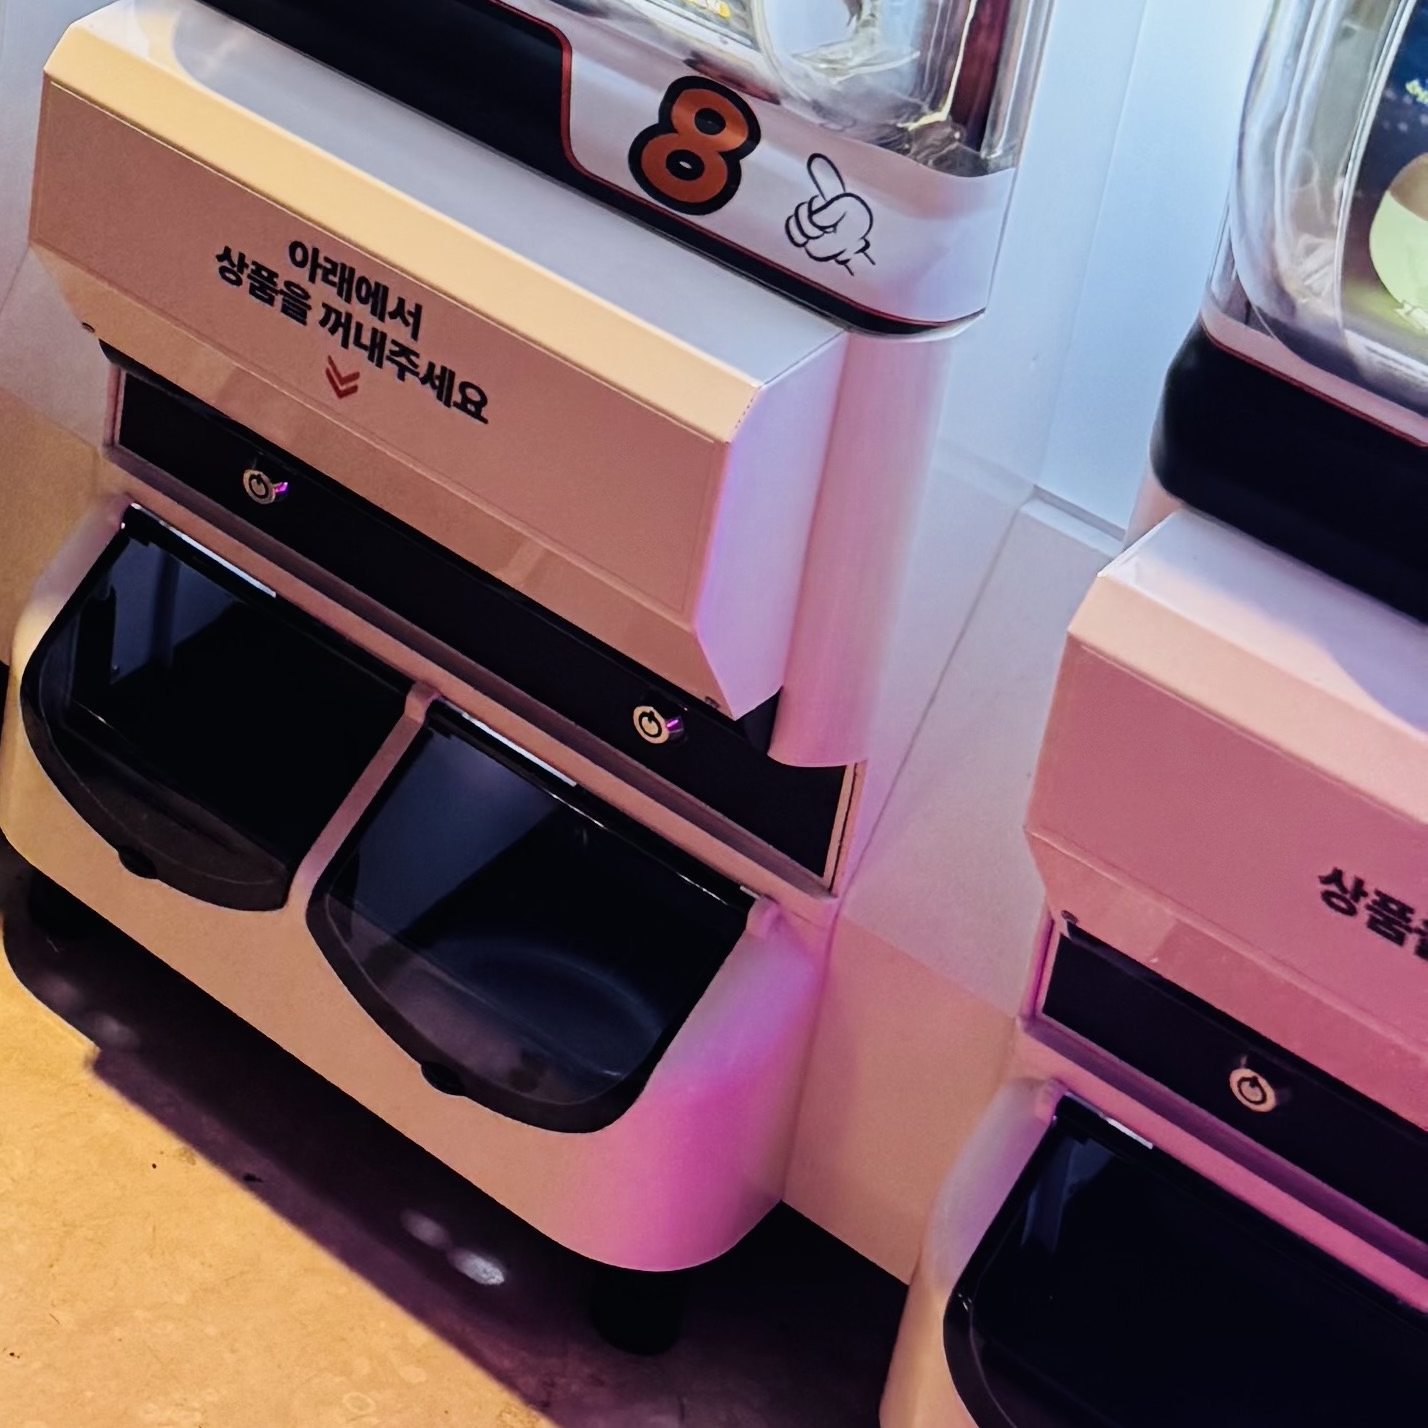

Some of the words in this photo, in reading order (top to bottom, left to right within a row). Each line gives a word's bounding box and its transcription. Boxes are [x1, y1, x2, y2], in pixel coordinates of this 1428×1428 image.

[628, 75, 762, 216] 8
[214, 244, 313, 325] 상품을
[318, 301, 490, 426] 꺼내주세요
[287, 238, 425, 340] 아래에서
